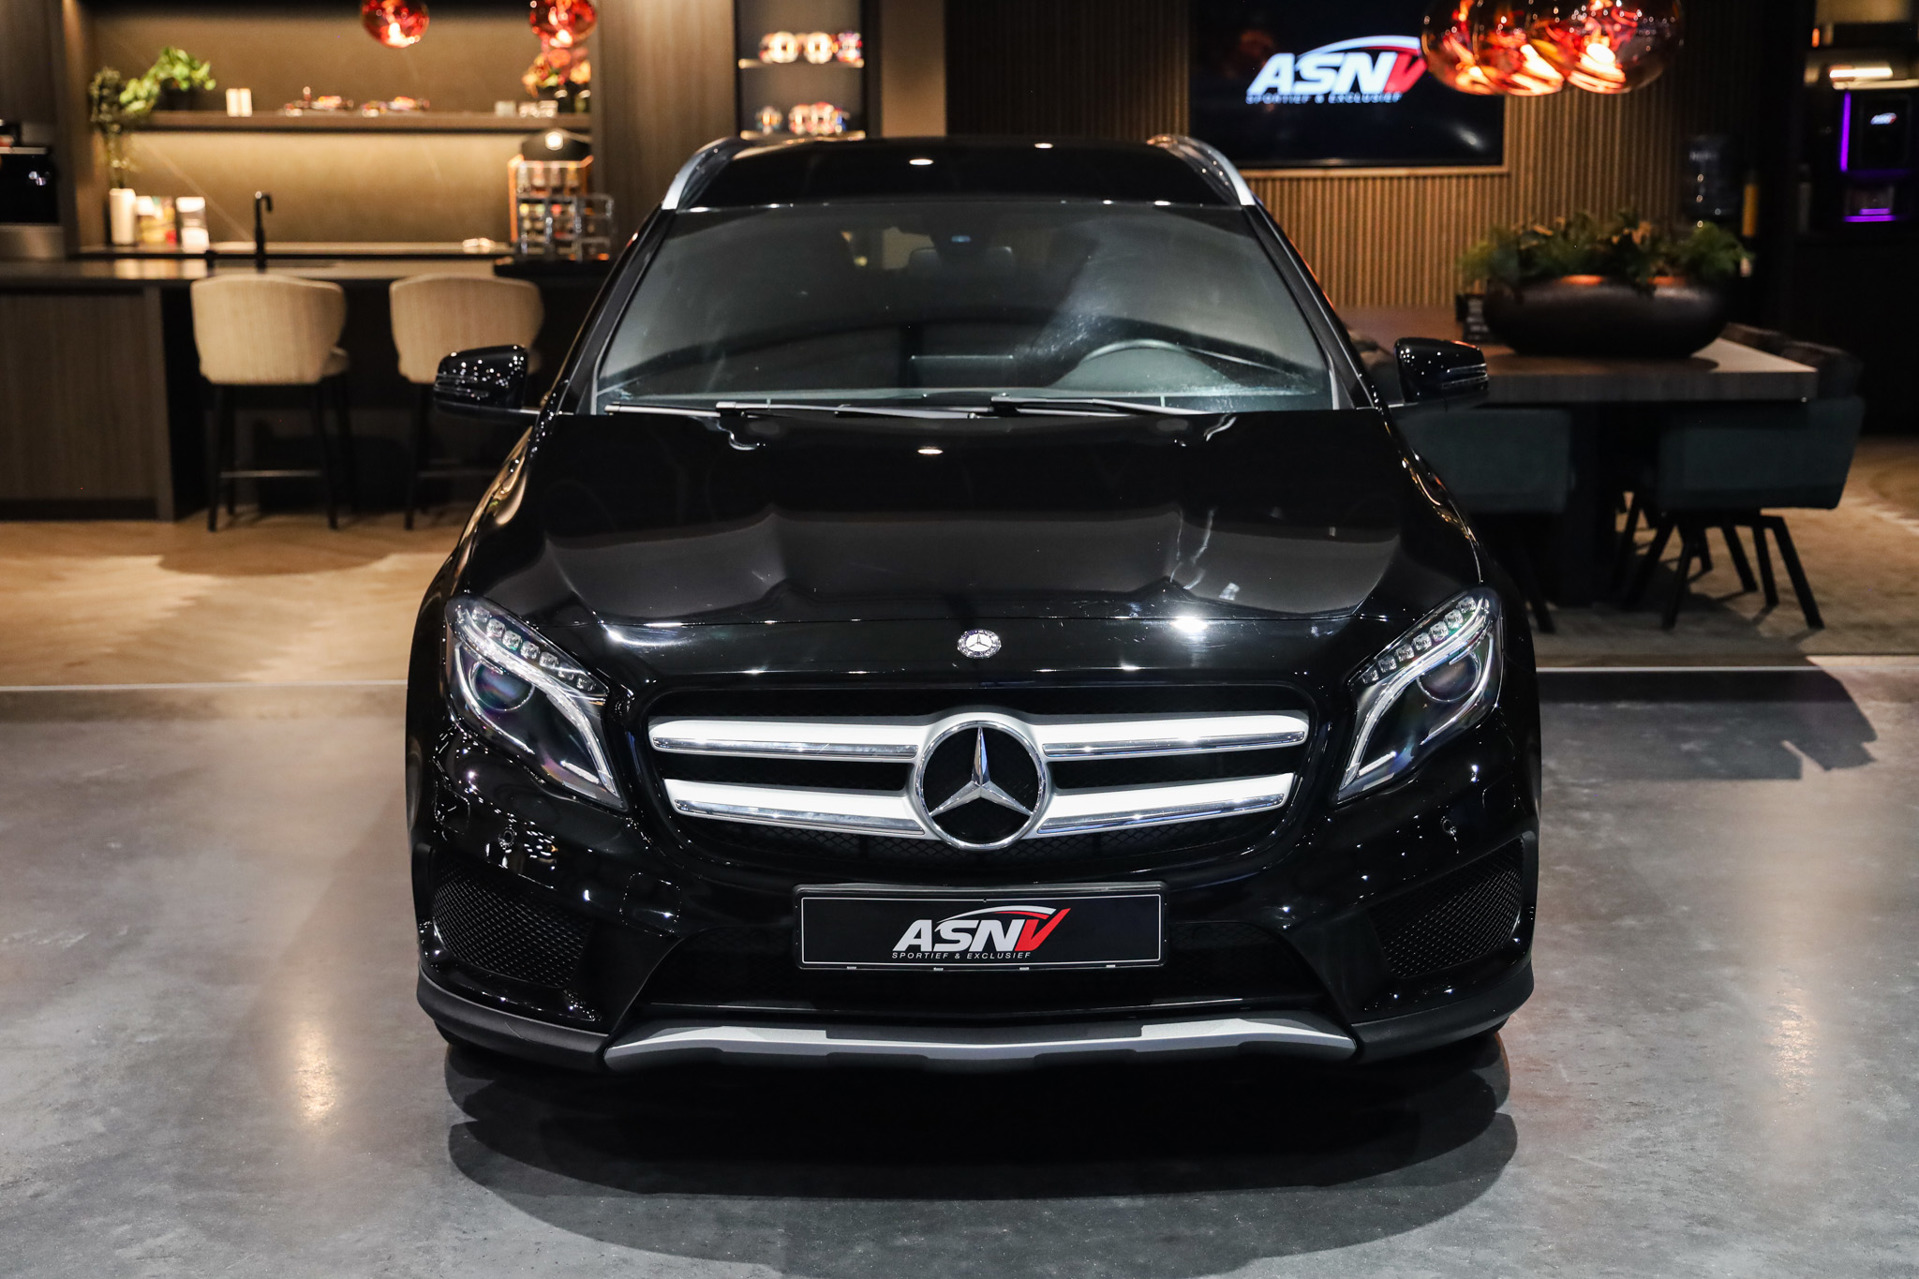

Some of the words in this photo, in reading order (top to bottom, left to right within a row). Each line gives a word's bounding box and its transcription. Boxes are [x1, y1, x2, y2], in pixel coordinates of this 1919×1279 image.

[892, 907, 1072, 952] ASNV
[891, 952, 949, 960] SPORTIEF
[954, 952, 961, 960] &
[966, 951, 1031, 960] EXCLUSIEF
